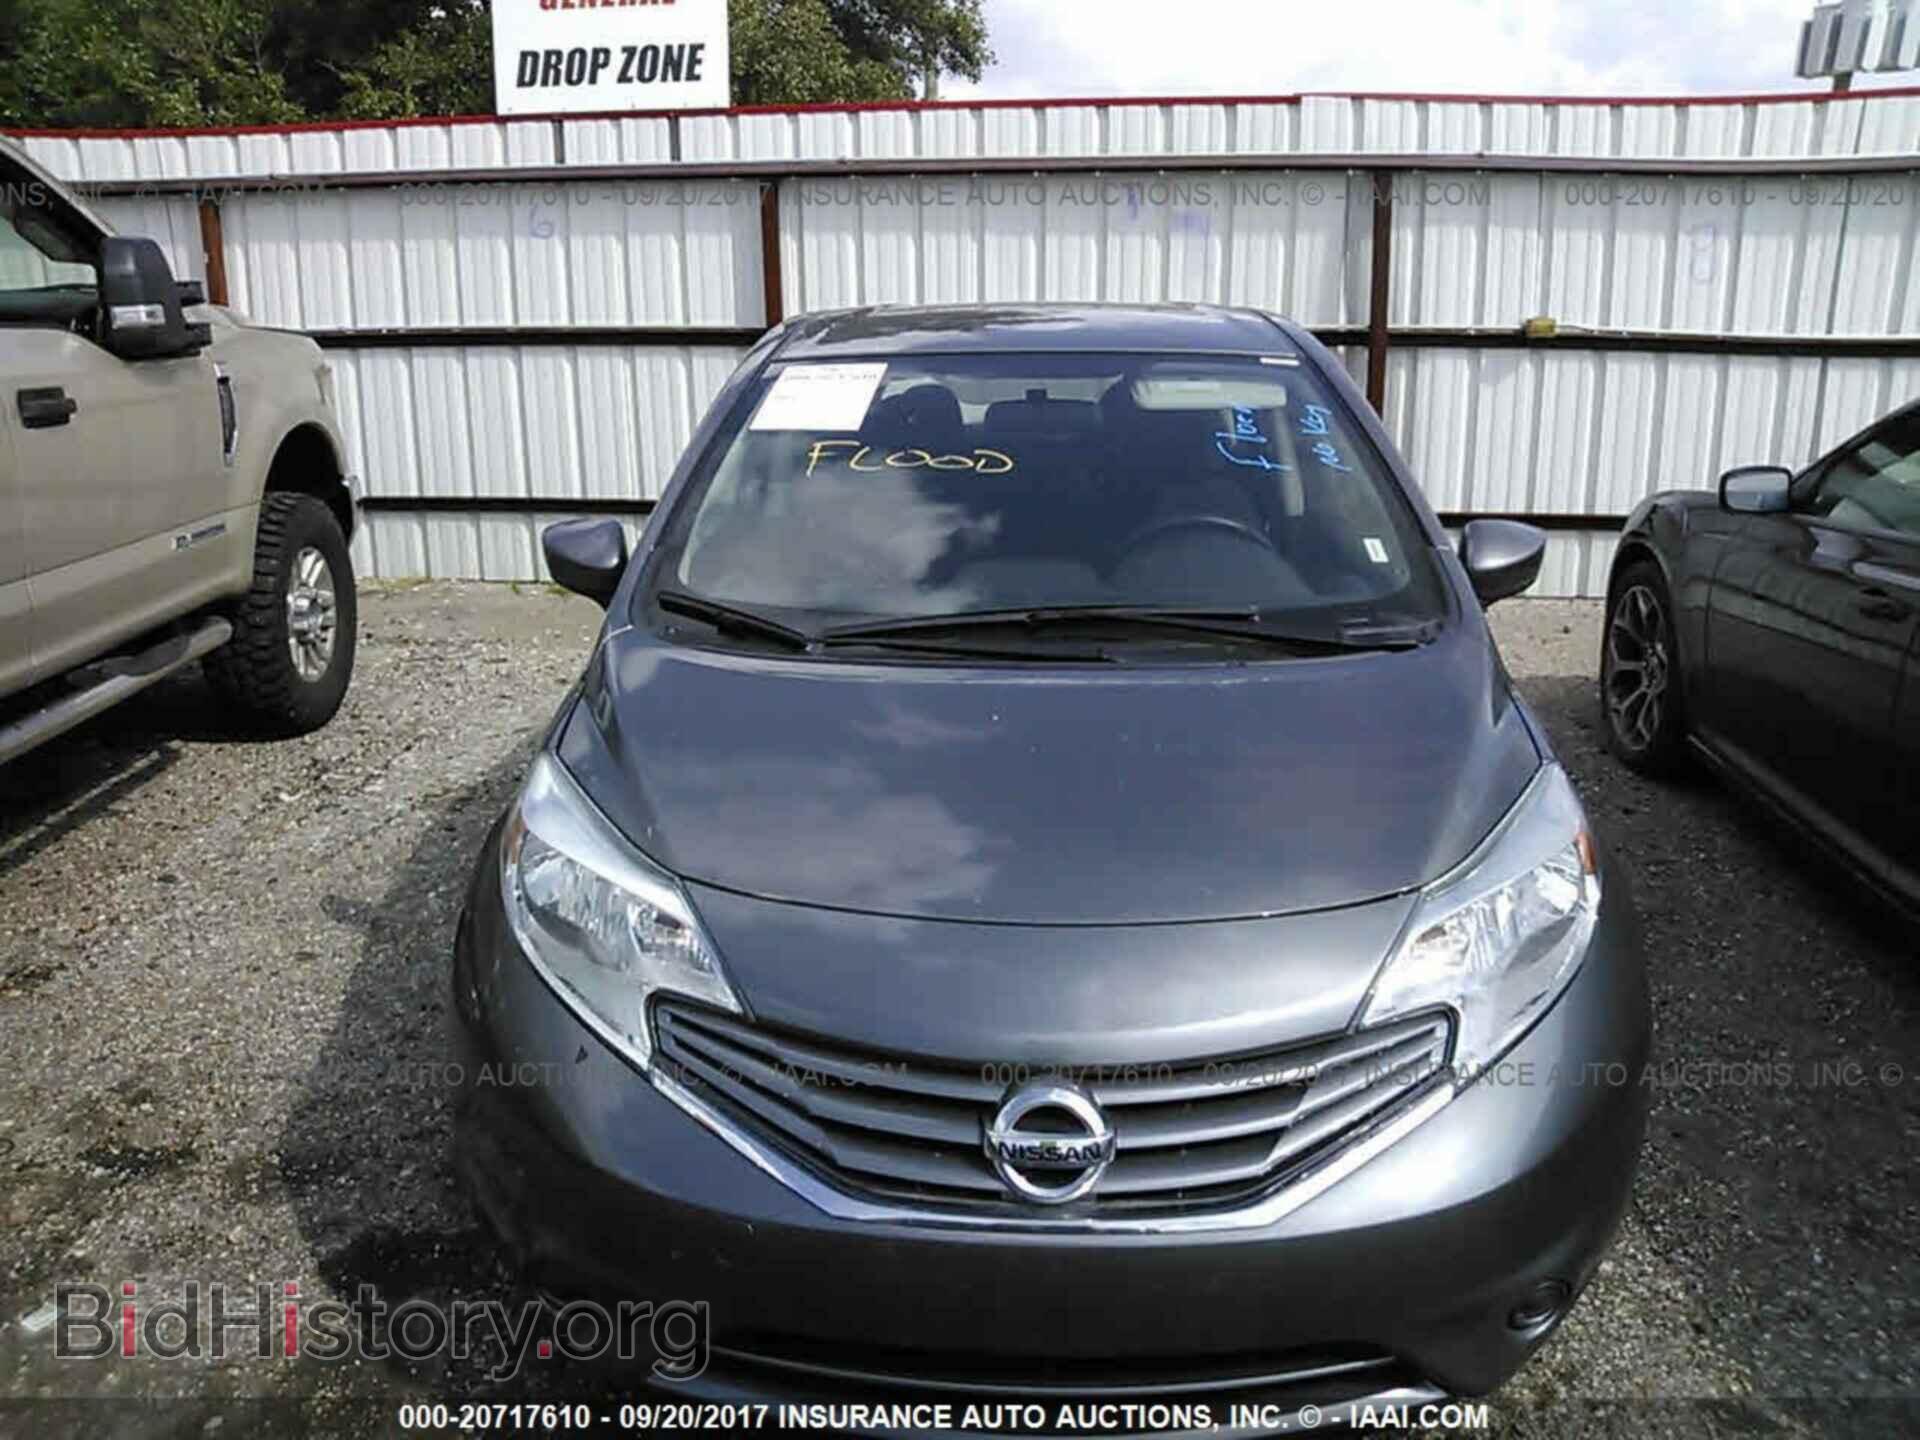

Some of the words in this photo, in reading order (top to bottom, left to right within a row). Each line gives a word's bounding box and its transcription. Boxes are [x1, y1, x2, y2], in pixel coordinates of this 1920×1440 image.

[516, 48, 610, 88] DROP
[616, 43, 705, 84] ZONE
[806, 439, 1013, 478] FLOOD
[998, 1141, 1100, 1162] NISSAN
